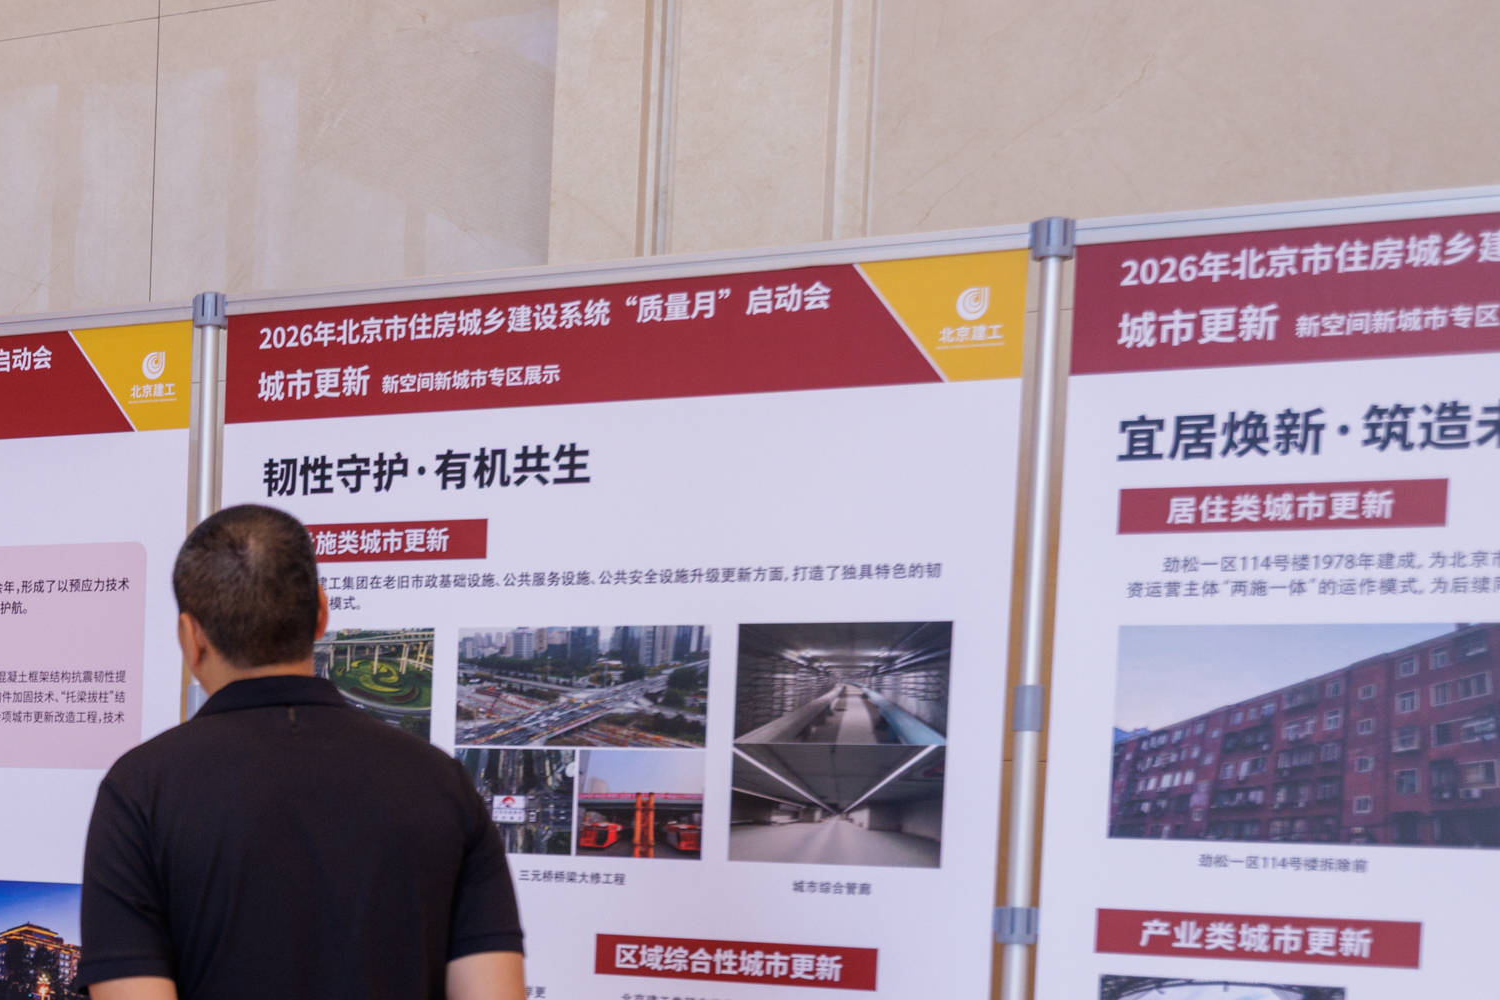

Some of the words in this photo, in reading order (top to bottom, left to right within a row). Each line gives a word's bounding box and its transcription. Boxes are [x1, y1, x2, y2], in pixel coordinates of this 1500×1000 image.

[259, 282, 831, 352] 2026年北京市住房城乡建设系统“质量月”启动会
[938, 323, 1004, 343] 北京建工
[1117, 303, 1279, 349] 城市更新
[1295, 303, 1500, 338] 新空间新城市专区
[130, 383, 176, 399] 北京建工
[258, 366, 370, 403] 城市更新
[382, 364, 560, 394] 新空间新城市专区展示
[263, 443, 591, 498] 韧性守护·有机共生
[1166, 489, 1394, 525] 居住类城市更新
[309, 527, 449, 555] 施类城市更新
[1139, 919, 1373, 958] 产业类城市更新
[615, 943, 843, 982] 区域综合性城市更新
